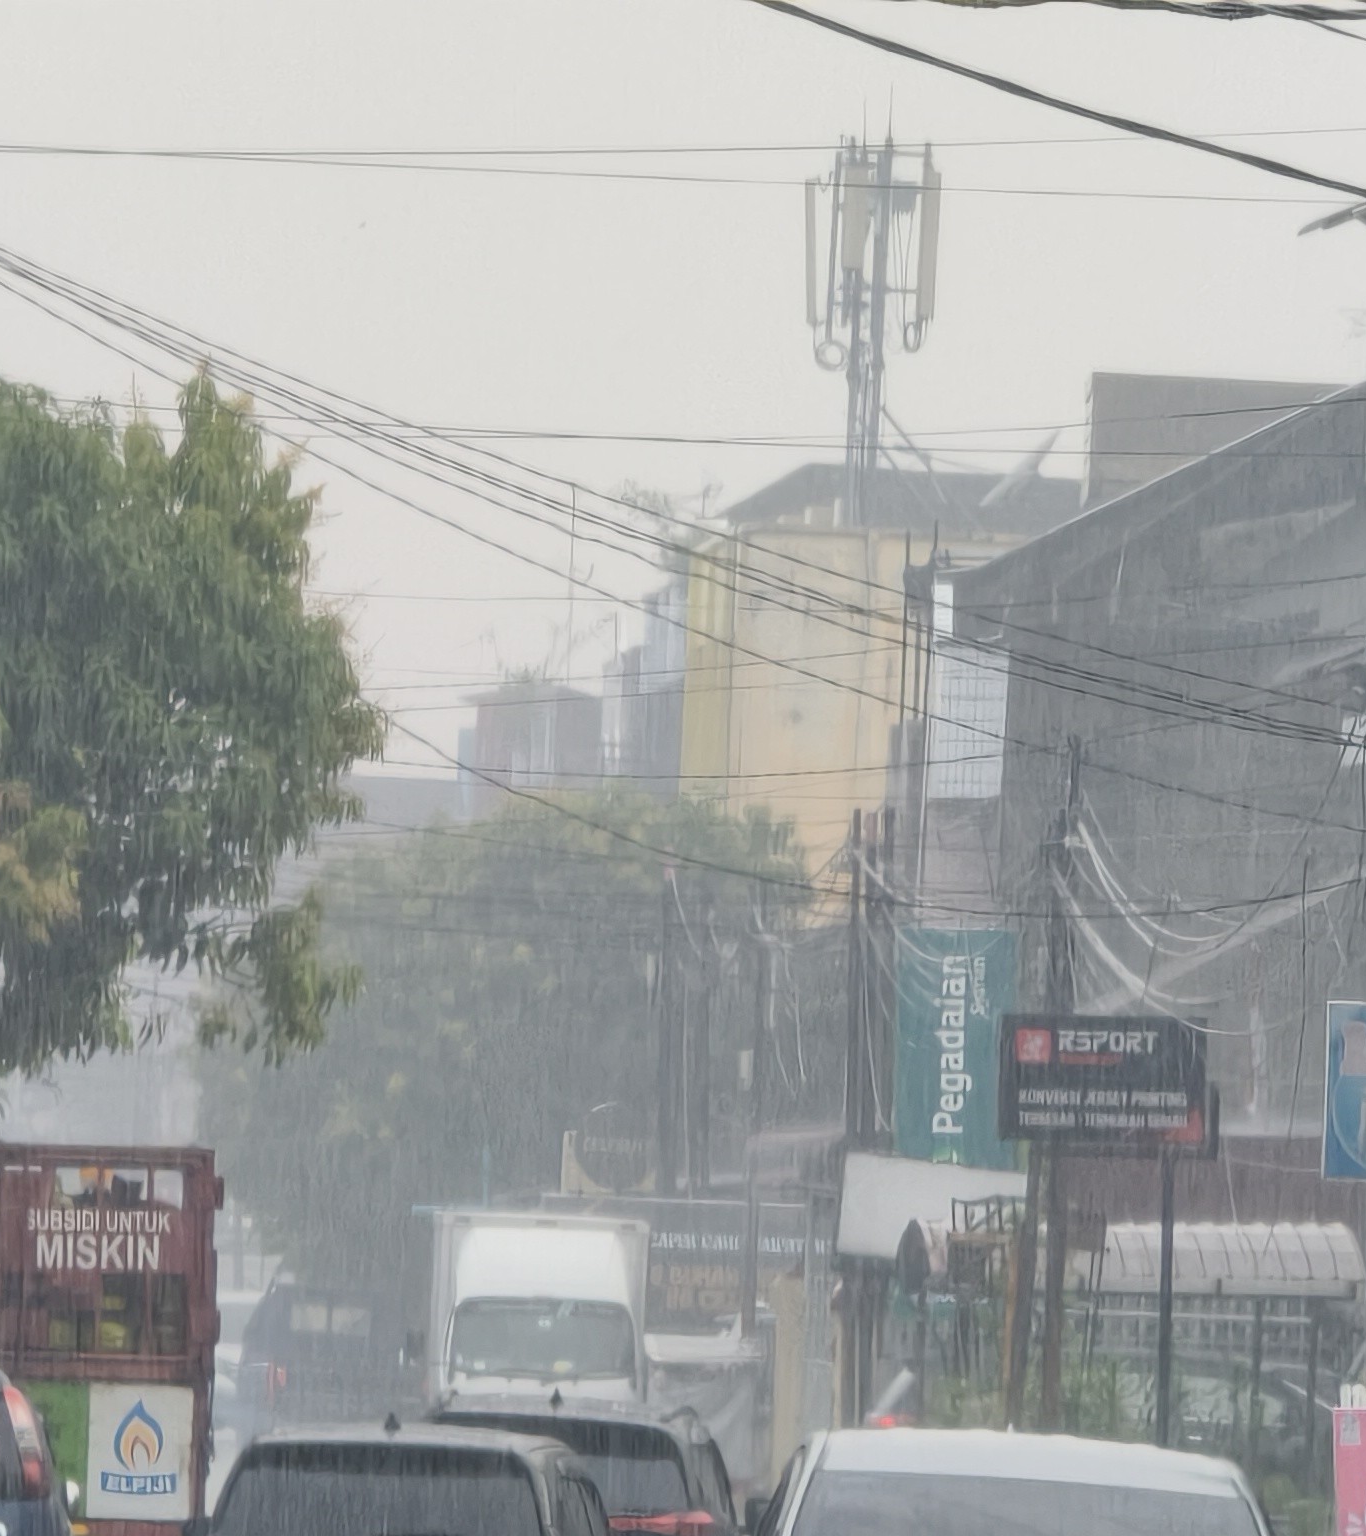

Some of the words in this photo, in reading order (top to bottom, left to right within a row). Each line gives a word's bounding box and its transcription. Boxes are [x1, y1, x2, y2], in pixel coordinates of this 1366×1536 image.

[931, 955, 973, 1134] Pegadaian
[27, 1208, 100, 1234] SUBSIDI
[106, 1209, 171, 1235] UNTUK
[36, 1234, 161, 1271] MISKIN
[105, 1474, 172, 1493] ELPIJI
